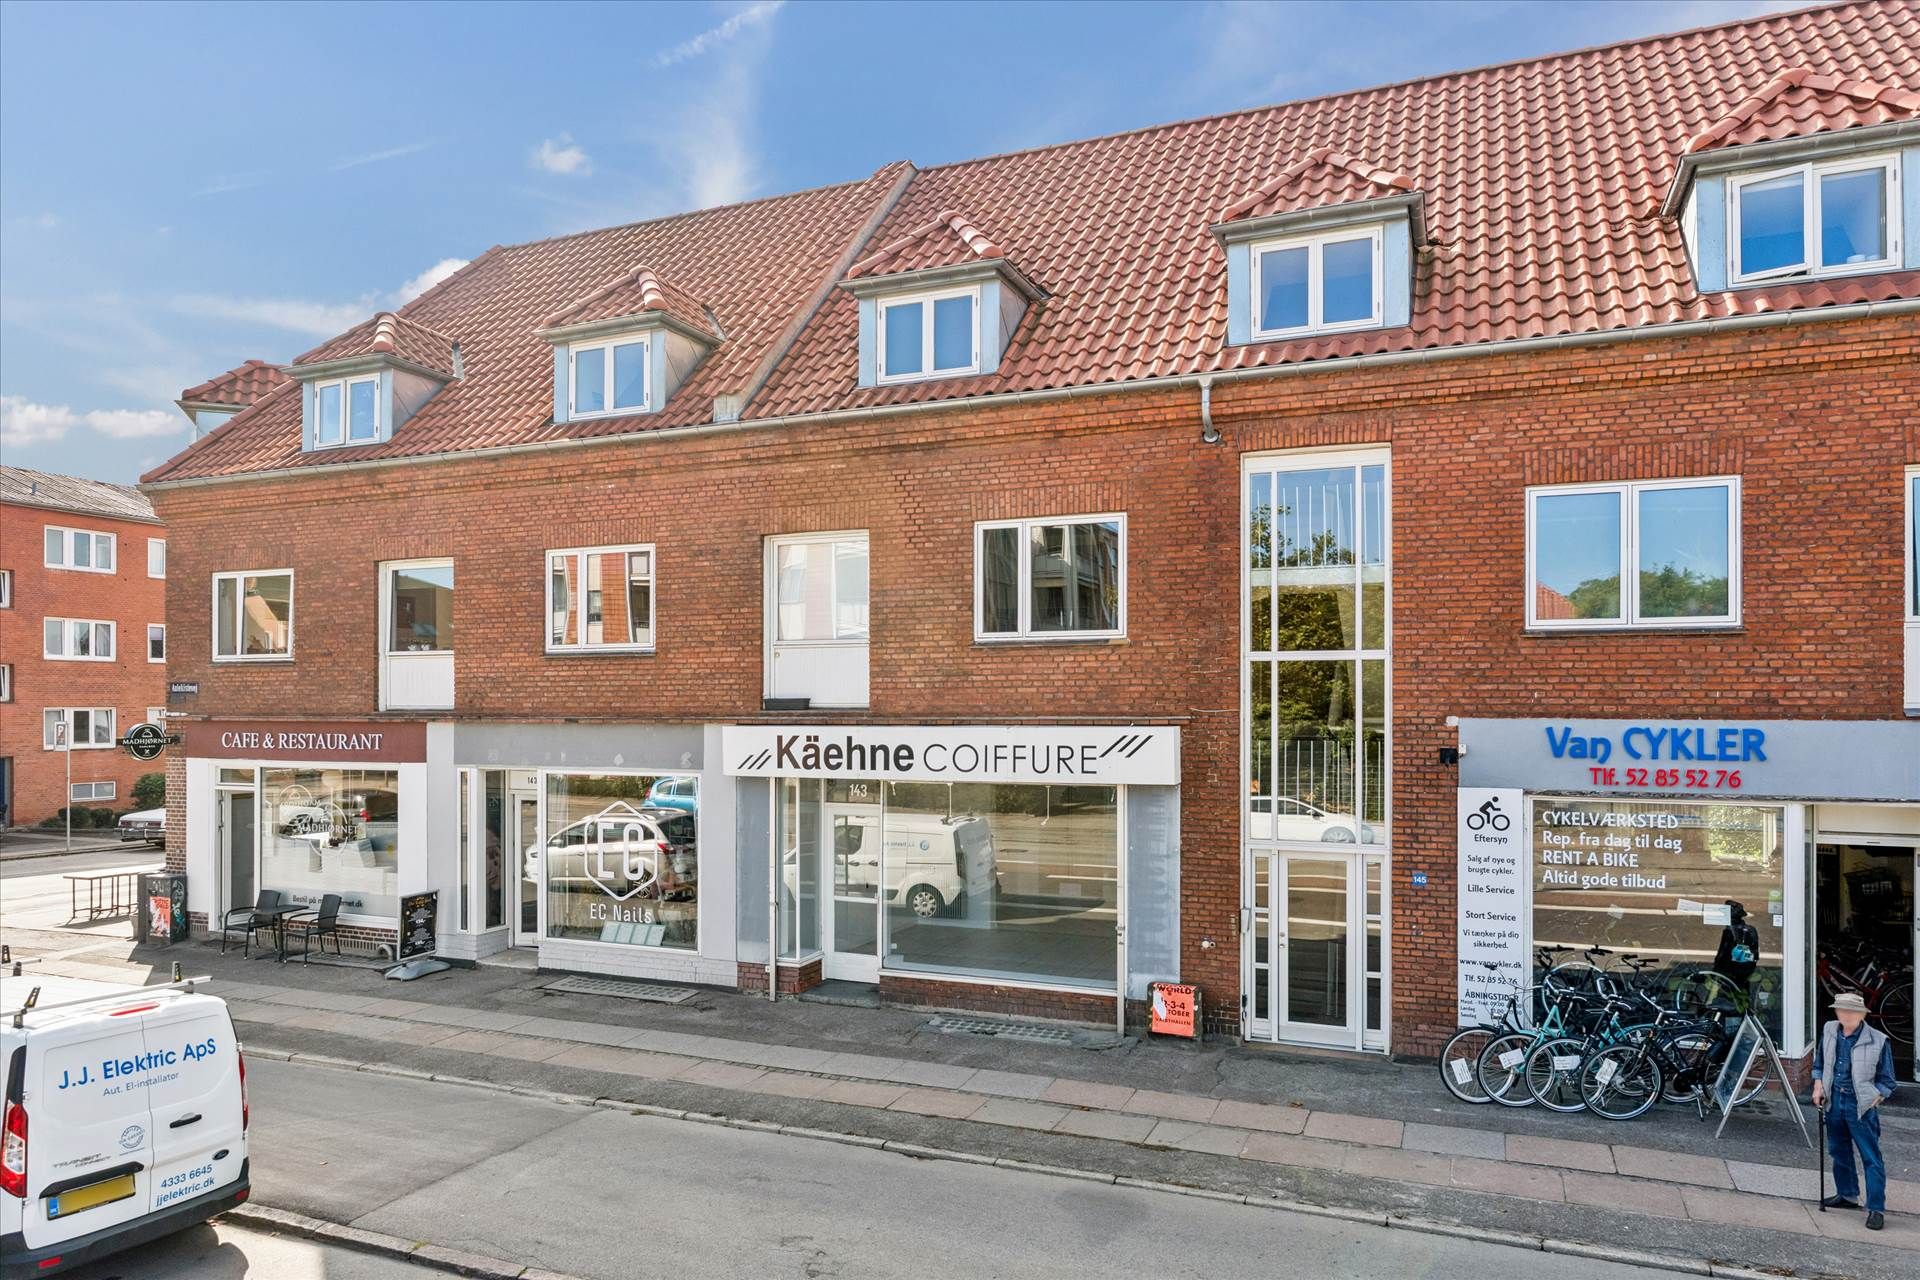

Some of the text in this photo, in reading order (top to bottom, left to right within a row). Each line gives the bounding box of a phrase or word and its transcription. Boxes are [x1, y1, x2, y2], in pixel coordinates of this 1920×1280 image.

[122, 737, 172, 745] MADHJØRNET
[222, 732, 383, 750] CAFE & RESTAURANT
[1545, 726, 1767, 764] Van CYKLER
[776, 735, 1098, 774] Käehne COIFFURE
[1589, 768, 1742, 788] Tlf. 52 85 52 76
[849, 784, 867, 798] 143
[1542, 811, 1679, 829] CYKELVÆRKSTED
[1474, 834, 1508, 845] Eftersyn
[1542, 830, 1682, 853] Rep. fra dag til dag
[1467, 855, 1481, 864] Salg
[1492, 857, 1505, 866] nye
[1506, 858, 1516, 866] og
[1542, 850, 1639, 868] RENT A BIKE
[1467, 866, 1515, 876] brugte cykler.
[1413, 876, 1427, 884] 145
[1542, 870, 1666, 889] Altid gode tilbud
[1467, 884, 1515, 895] Lille Service
[590, 903, 653, 923] EC Nails
[1465, 910, 1517, 921] Stort Service
[1463, 929, 1519, 939] Vi tænker på din
[1473, 941, 1509, 950] sikkerhed.
[1487, 976, 1496, 984] 85
[1465, 988, 1519, 1002] ÅBNINGSTIDR
[1168, 1010, 1190, 1018] TOBER
[58, 1038, 217, 1090] J.J. Elektric ApS
[103, 1072, 179, 1097] Aut. El-installator
[161, 1164, 213, 1188] 4333 6645
[156, 1177, 215, 1207] jjelektric.dk
